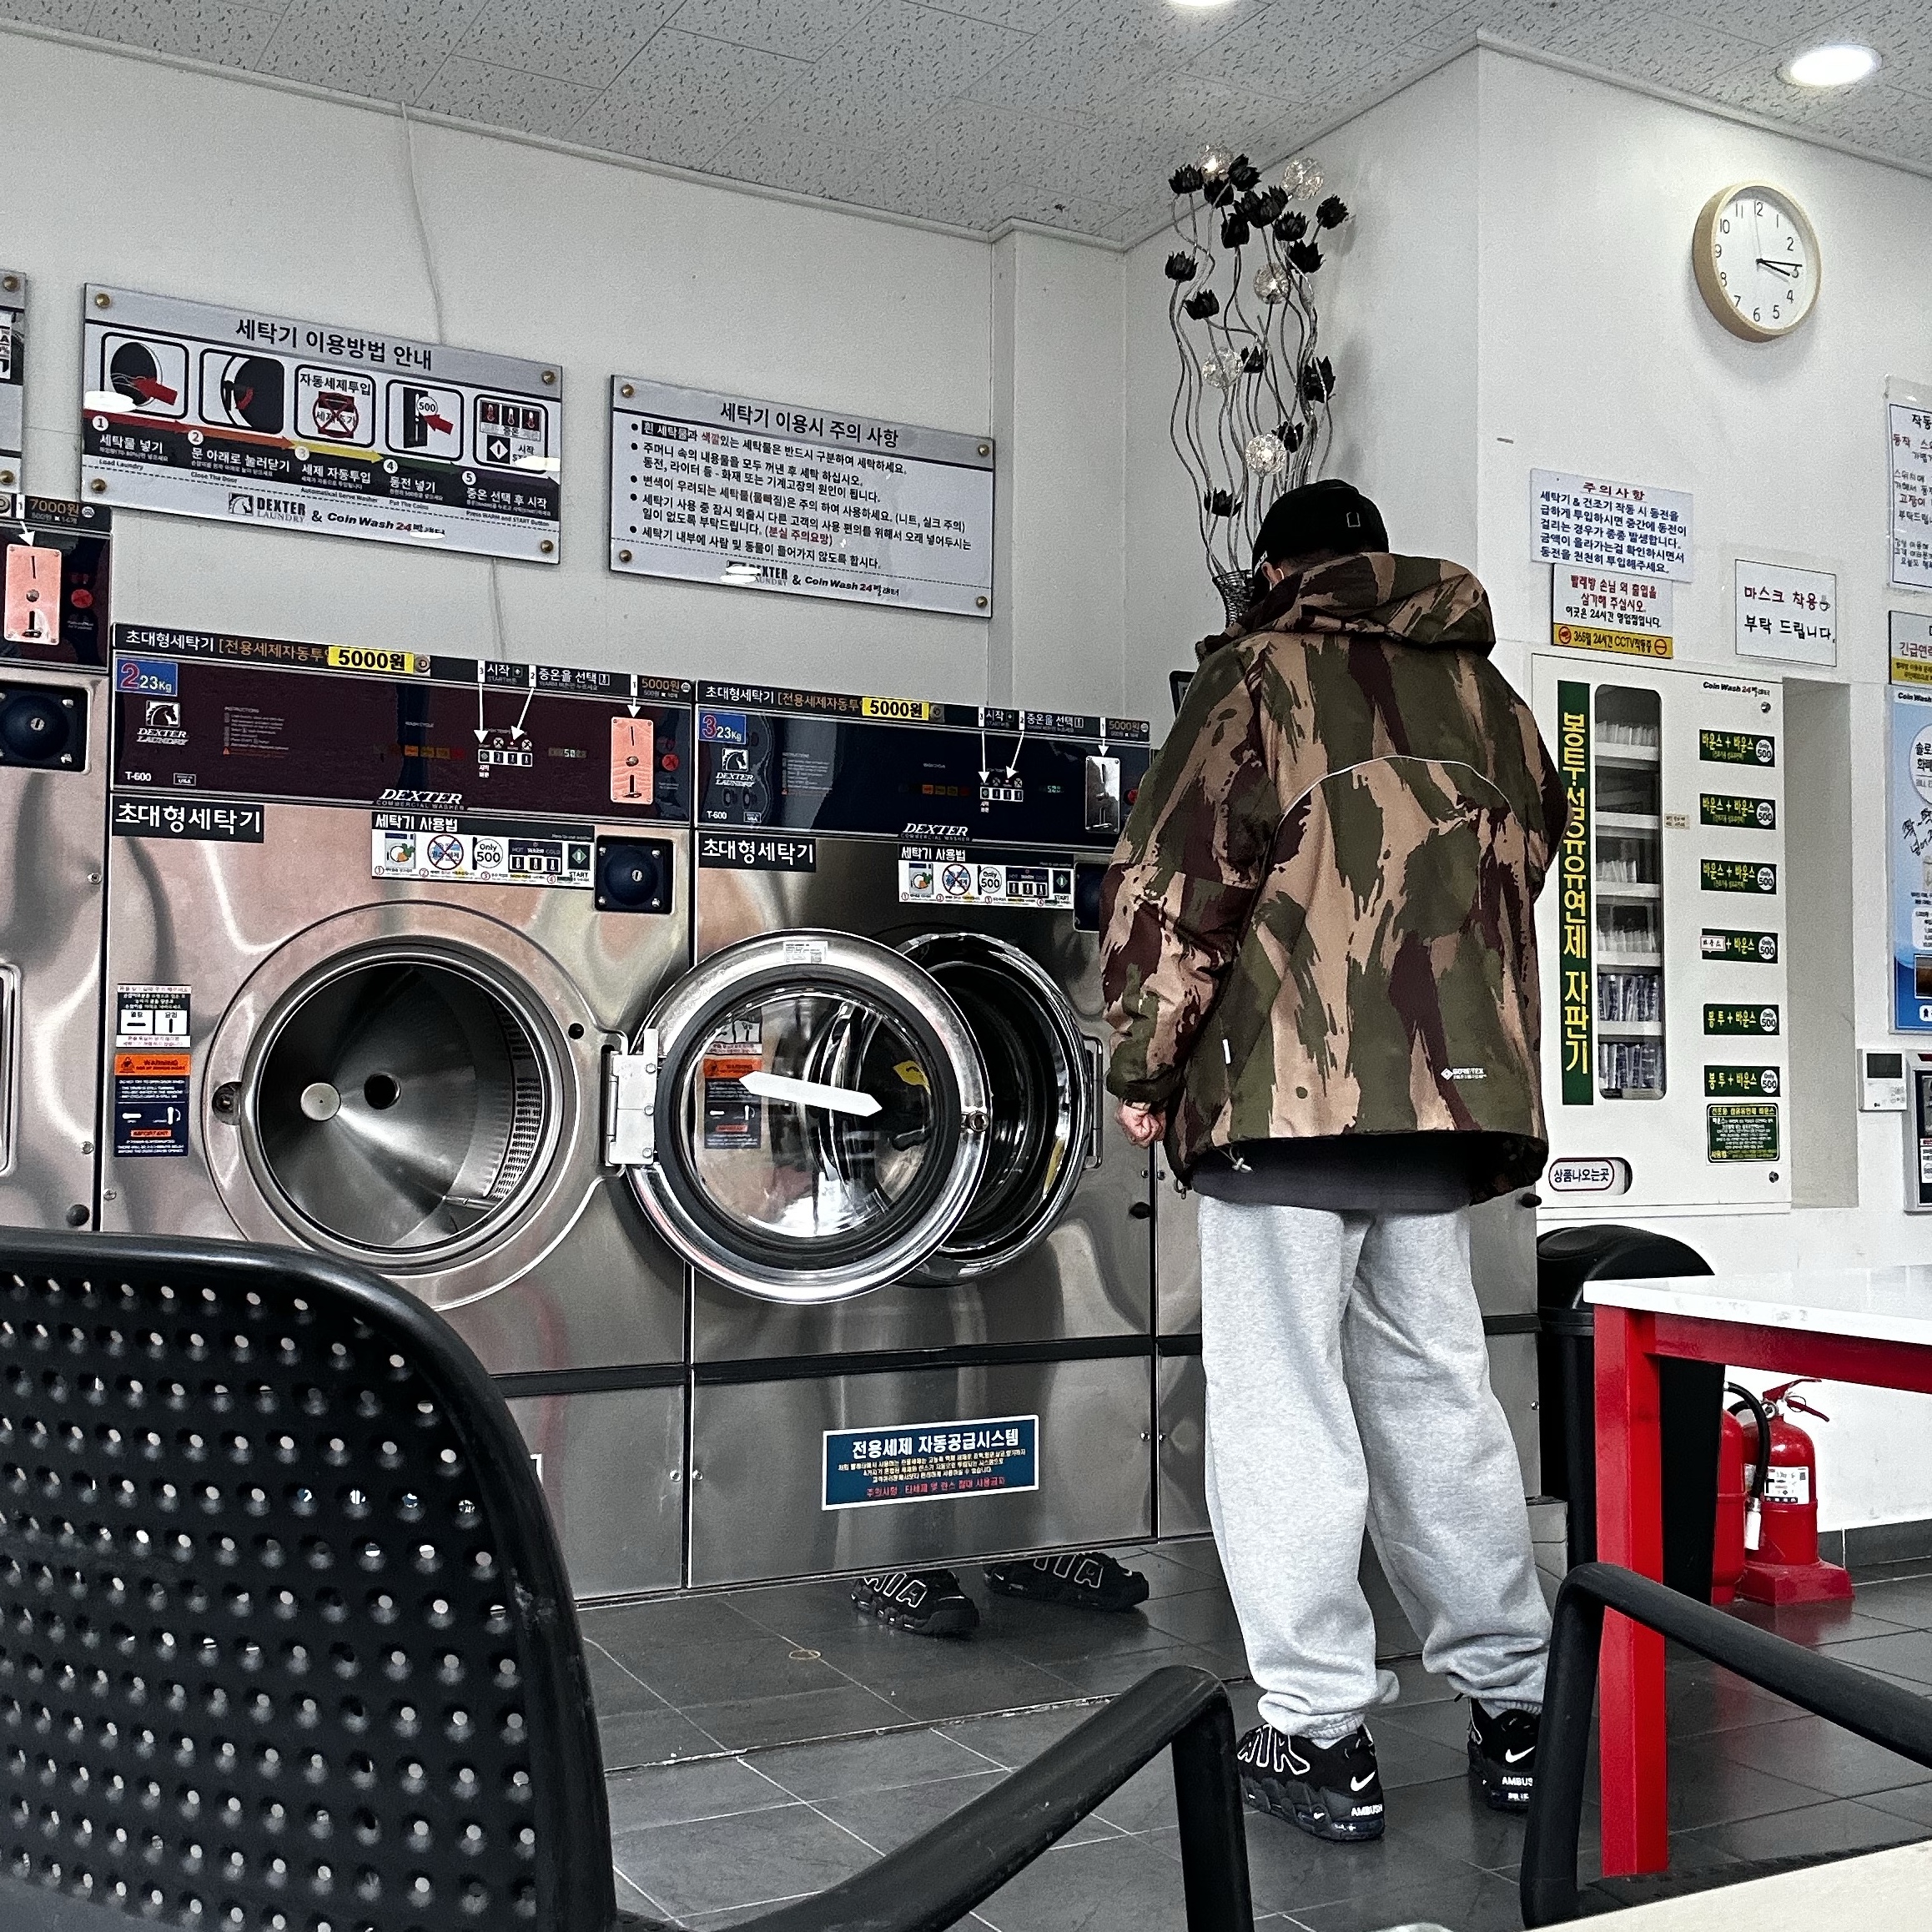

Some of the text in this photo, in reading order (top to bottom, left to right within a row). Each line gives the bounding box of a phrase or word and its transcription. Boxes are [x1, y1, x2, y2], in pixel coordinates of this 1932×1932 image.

[1736, 200, 1743, 219] 11
[1753, 199, 1763, 217] 12
[1720, 219, 1730, 234] 10
[1715, 244, 1722, 258] 9
[1787, 236, 1794, 251] 2
[1720, 272, 1728, 287] 8
[1734, 294, 1741, 307] 7
[1786, 289, 1794, 304] 4
[1753, 307, 1761, 322] 6
[1773, 304, 1780, 319] 5
[235, 319, 432, 371] 세탁기 이용방법 안내
[299, 373, 371, 396] 자동세제투입
[418, 402, 436, 413] 500
[721, 402, 899, 449] 세탁기 이용시 주의 사항
[99, 433, 137, 450] 세탁물
[191, 447, 242, 465] 문 아래로
[643, 441, 863, 487] 주머니 속의 내용물을 모두 세탁 하십시오.
[784, 445, 813, 460] 반드시
[816, 450, 854, 467] 구분하여
[857, 457, 908, 475] 세탁하세요.
[301, 463, 324, 479] 세제
[327, 466, 371, 484] 자동투입
[670, 460, 881, 503] 라이터 화재 또는 기계고장의 원인이 됩니다.
[390, 475, 411, 491] 동전
[29, 499, 79, 517] 7000원
[257, 496, 306, 516] DEXTER
[491, 491, 511, 506] 선택
[527, 496, 547, 510] 시작
[643, 475, 966, 534] 변색이 우려되는 주의 하여 사용하세요. 실크 주의)
[1540, 490, 1679, 522] 세탁기 건조기 작동 동전을
[327, 512, 395, 530] Coin Wash
[642, 493, 972, 551] 세탁기 사용 잠시 외출시 다른 고객의 사용 편의를 위해서 오래 넣어두시는
[642, 508, 833, 546] 일이 없도록 부탁드립니다. 주의요망)
[1540, 504, 1571, 519] 급하게
[1572, 508, 1623, 527] 투입하시면
[1658, 521, 1687, 536] 동전이
[1573, 522, 1604, 537] 경우가
[1628, 531, 1682, 550] 발생합니다.
[641, 526, 881, 569] 세탁기 내부에 사람 동물이 들어가지 않도록 합시다.
[1540, 546, 1669, 574] 동전을 천천히 투입해주세요.
[805, 575, 858, 591] Coin Wash
[1599, 578, 1616, 594] 손님
[1632, 582, 1658, 600] 출입을
[1743, 586, 1818, 611] 마스크 착용
[1590, 608, 1614, 623] 24시간
[1743, 614, 1836, 644] 부탁 드립니다.
[126, 630, 214, 652] 초대형세탁기
[338, 650, 405, 672] 5000원
[120, 662, 172, 693] 2 23Kg
[486, 664, 511, 677] 시작
[538, 667, 597, 685] 중온을 선택
[641, 677, 680, 693] 5000원
[706, 686, 774, 705] 초대형세탁기
[870, 699, 923, 718] 5000원
[986, 710, 1004, 722] 시작
[1055, 716, 1073, 727] 선택
[137, 727, 188, 738] DEXTER
[702, 714, 717, 738] 3
[1108, 720, 1140, 733] 5000원
[125, 771, 152, 782] T-600
[379, 788, 463, 805] DEXTER
[115, 802, 260, 835] 초대형세탁기
[375, 813, 458, 833] 세탁기 사용법
[706, 810, 727, 820] T-600
[903, 823, 969, 837] DEXTER
[476, 851, 501, 863] 500
[479, 843, 497, 853] Only
[701, 838, 813, 866] 초대형세탁기
[901, 846, 966, 862] 세탁기 사용법
[981, 878, 1000, 888] 500
[1563, 970, 1588, 1074] 자판기
[1553, 1168, 1610, 1183] 상품나오는곳
[852, 1427, 1019, 1460] 전용세제 자동공급시스템
[1502, 1776, 1533, 1787] AMBUS
[1351, 1804, 1383, 1817] AMBUSH
